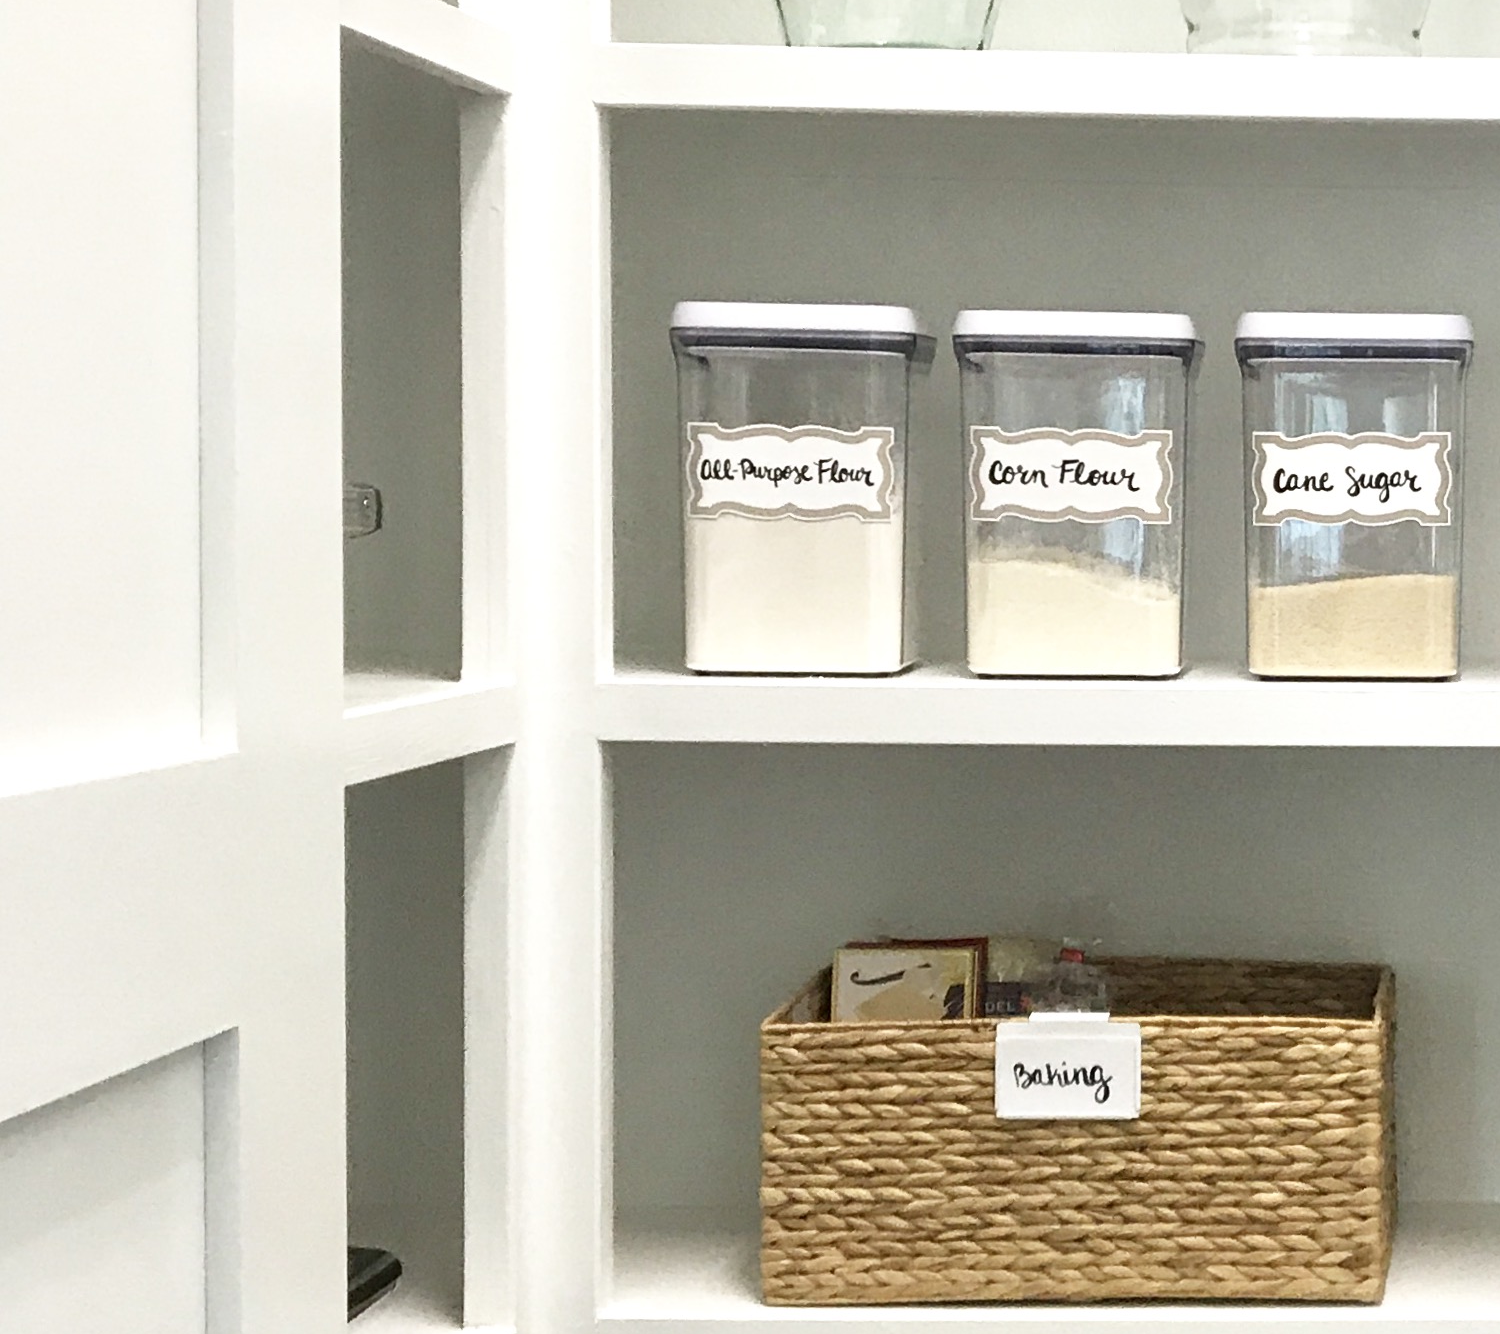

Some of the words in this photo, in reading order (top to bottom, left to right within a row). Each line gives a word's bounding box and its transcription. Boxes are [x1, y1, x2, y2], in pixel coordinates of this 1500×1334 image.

[815, 456, 875, 488] Flour
[988, 459, 1049, 488] Corn
[1058, 457, 1140, 493] Flour
[1345, 464, 1422, 503] Sugar
[1013, 1062, 1113, 1105] Baking
